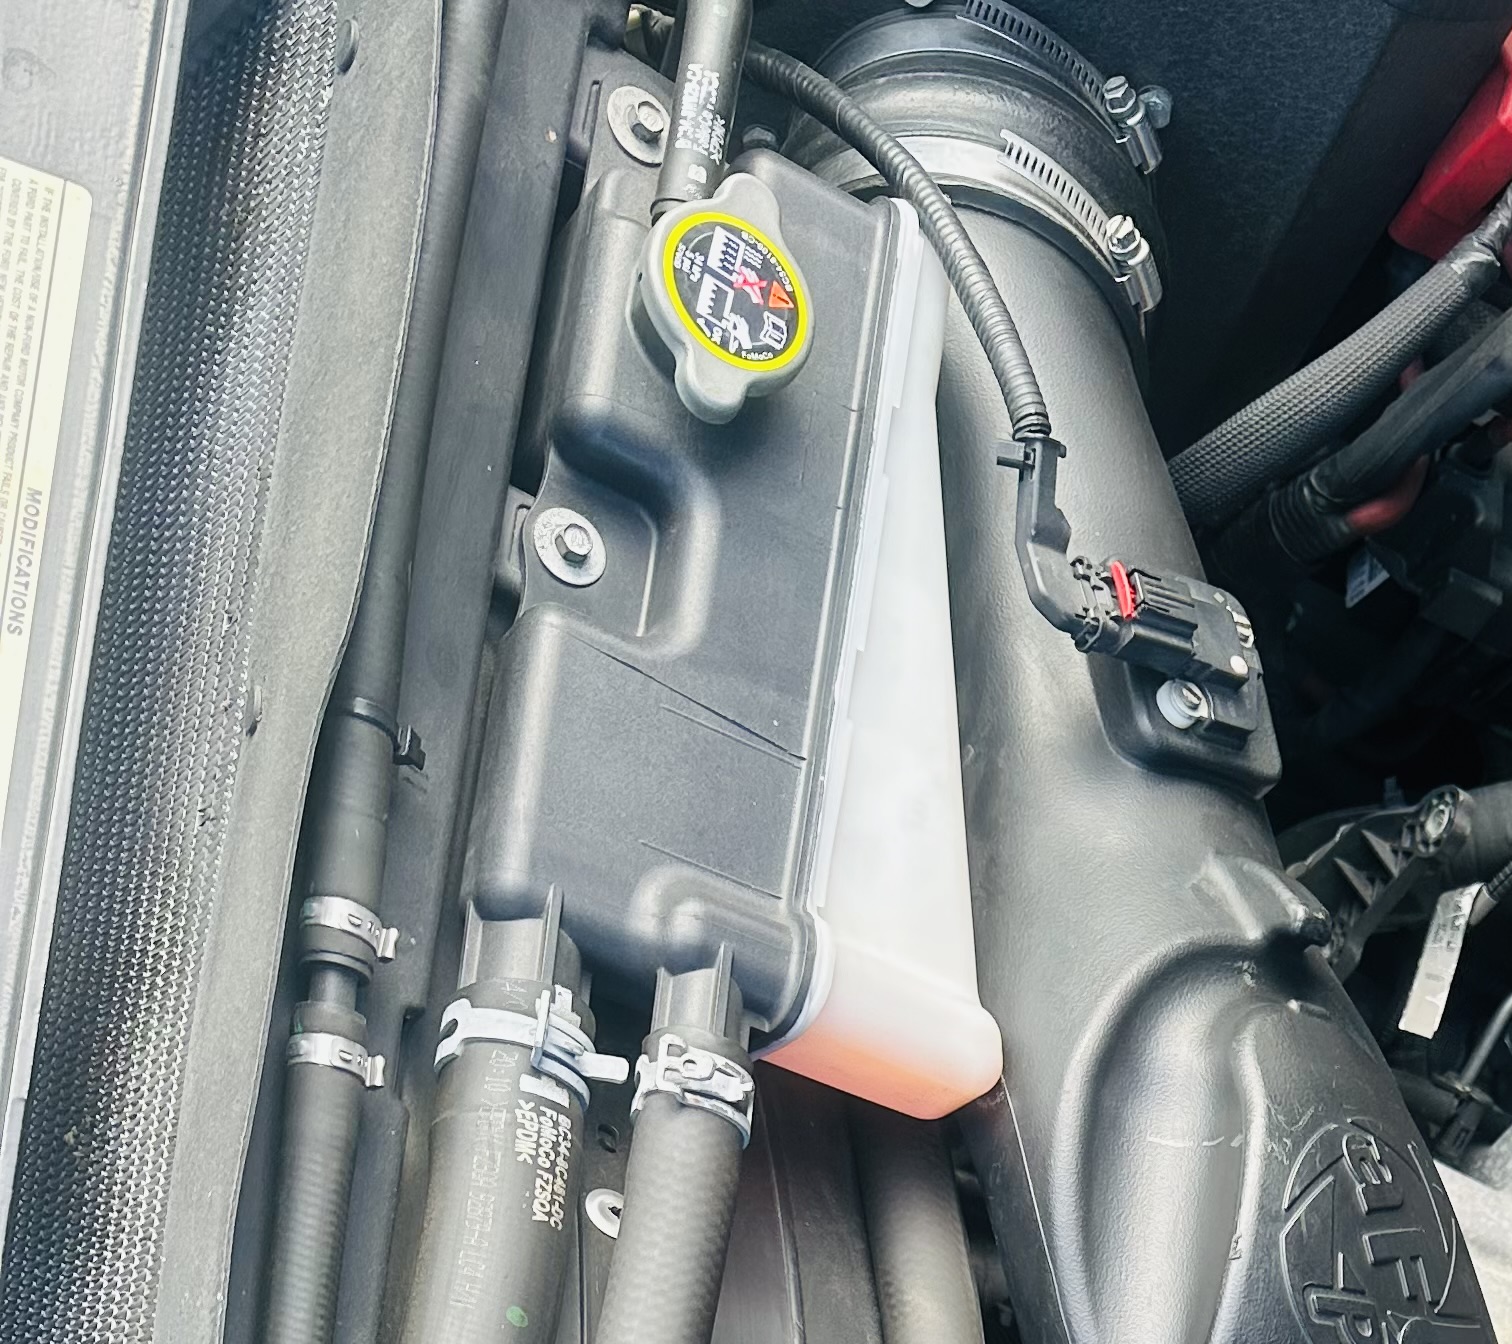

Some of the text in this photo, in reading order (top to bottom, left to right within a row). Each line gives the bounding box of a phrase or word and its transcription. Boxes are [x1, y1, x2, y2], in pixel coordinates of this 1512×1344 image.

[8, 179, 22, 215] COVERED
[25, 187, 37, 209] FORD
[41, 198, 52, 212] THE
[22, 212, 34, 232] PART
[4, 232, 14, 246] THE
[30, 215, 49, 291] INSTALLATION/USE
[15, 270, 26, 284] THE
[12, 287, 24, 308] COST
[7, 325, 18, 340] THE
[21, 314, 36, 355] NON-FORD
[3, 343, 15, 371] REPAIR
[742, 351, 773, 361] FoMoCo
[16, 358, 28, 386] MOTOR
[10, 389, 24, 428] COMPANY
[4, 432, 18, 470] PRODUCT
[1, 472, 13, 495] FAILS
[6, 487, 42, 636] MODIFICATIONS
[532, 1106, 557, 1221] FoMoCo FZSQA
